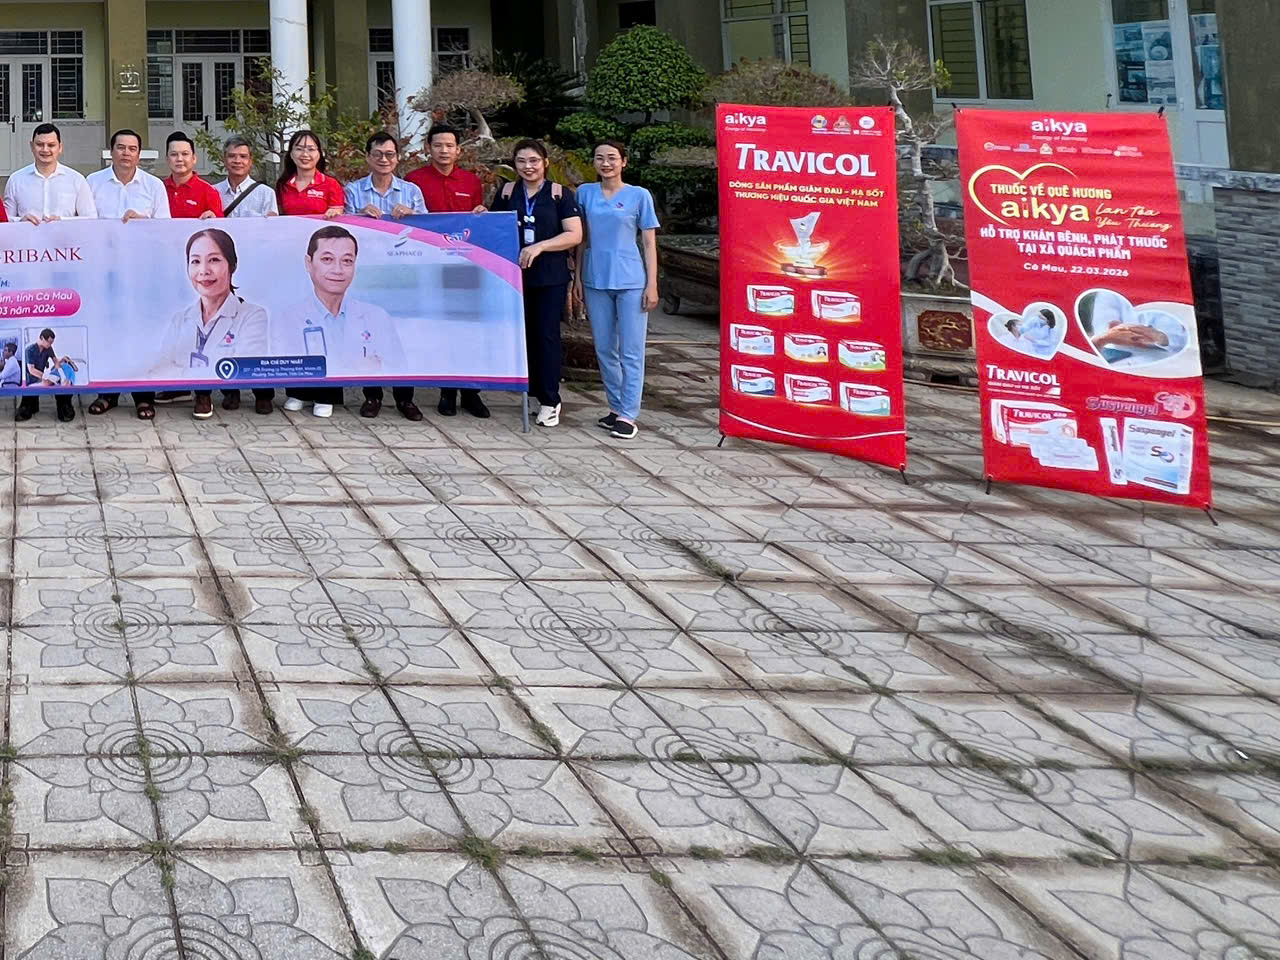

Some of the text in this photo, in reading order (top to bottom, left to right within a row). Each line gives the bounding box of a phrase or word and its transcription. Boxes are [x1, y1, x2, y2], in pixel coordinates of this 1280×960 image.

[725, 112, 767, 128] aikya
[1031, 118, 1088, 136] aikya
[734, 142, 878, 178] TRAVICOL
[823, 186, 843, 195] ĐAU
[990, 181, 1028, 196] THUỐC
[1047, 184, 1070, 198] QUÊ
[818, 196, 836, 205] GIA
[836, 196, 856, 208] VIỆT
[857, 199, 880, 208] NAM
[1000, 196, 1090, 226] aikya
[1022, 227, 1056, 242] KHÁM
[1127, 235, 1169, 249] THUỐC
[1017, 242, 1038, 256] TẠI
[1039, 242, 1056, 255] XÃ
[1056, 243, 1096, 258] QUÁCH
[1070, 265, 1130, 277] 22.03.2026
[35, 291, 51, 301] Cà
[51, 290, 74, 301] Mau
[10, 305, 31, 315] năm
[31, 303, 57, 314] 2026
[985, 364, 1061, 387] TRAVICOL
